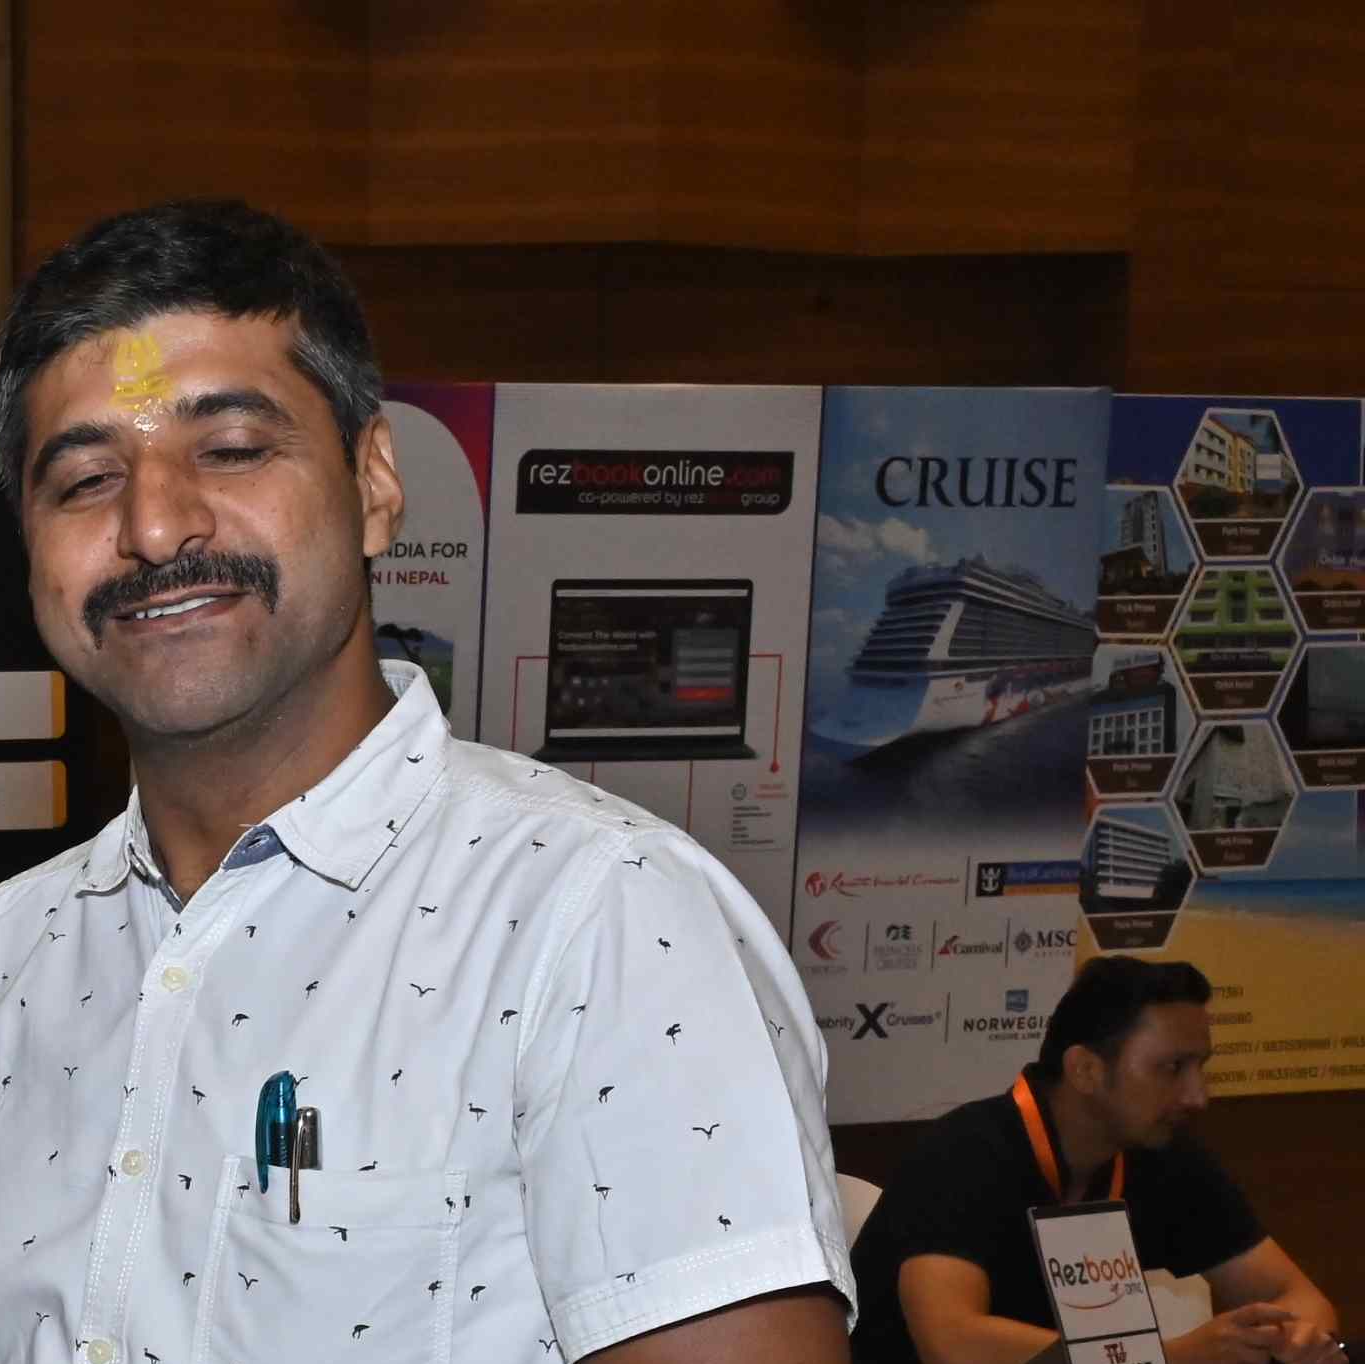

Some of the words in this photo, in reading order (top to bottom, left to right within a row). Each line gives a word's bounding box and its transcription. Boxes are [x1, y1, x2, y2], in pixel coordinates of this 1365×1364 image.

[875, 455, 1078, 509] CRUISE
[431, 543, 469, 559] FOR
[396, 570, 450, 585] NEPAL
[1037, 929, 1078, 949] MSC
[815, 1014, 855, 1032] ebrity
[852, 1003, 889, 1040] X
[964, 1016, 1055, 1032] NORWEGI
[1048, 1249, 1140, 1288] Rezbook
